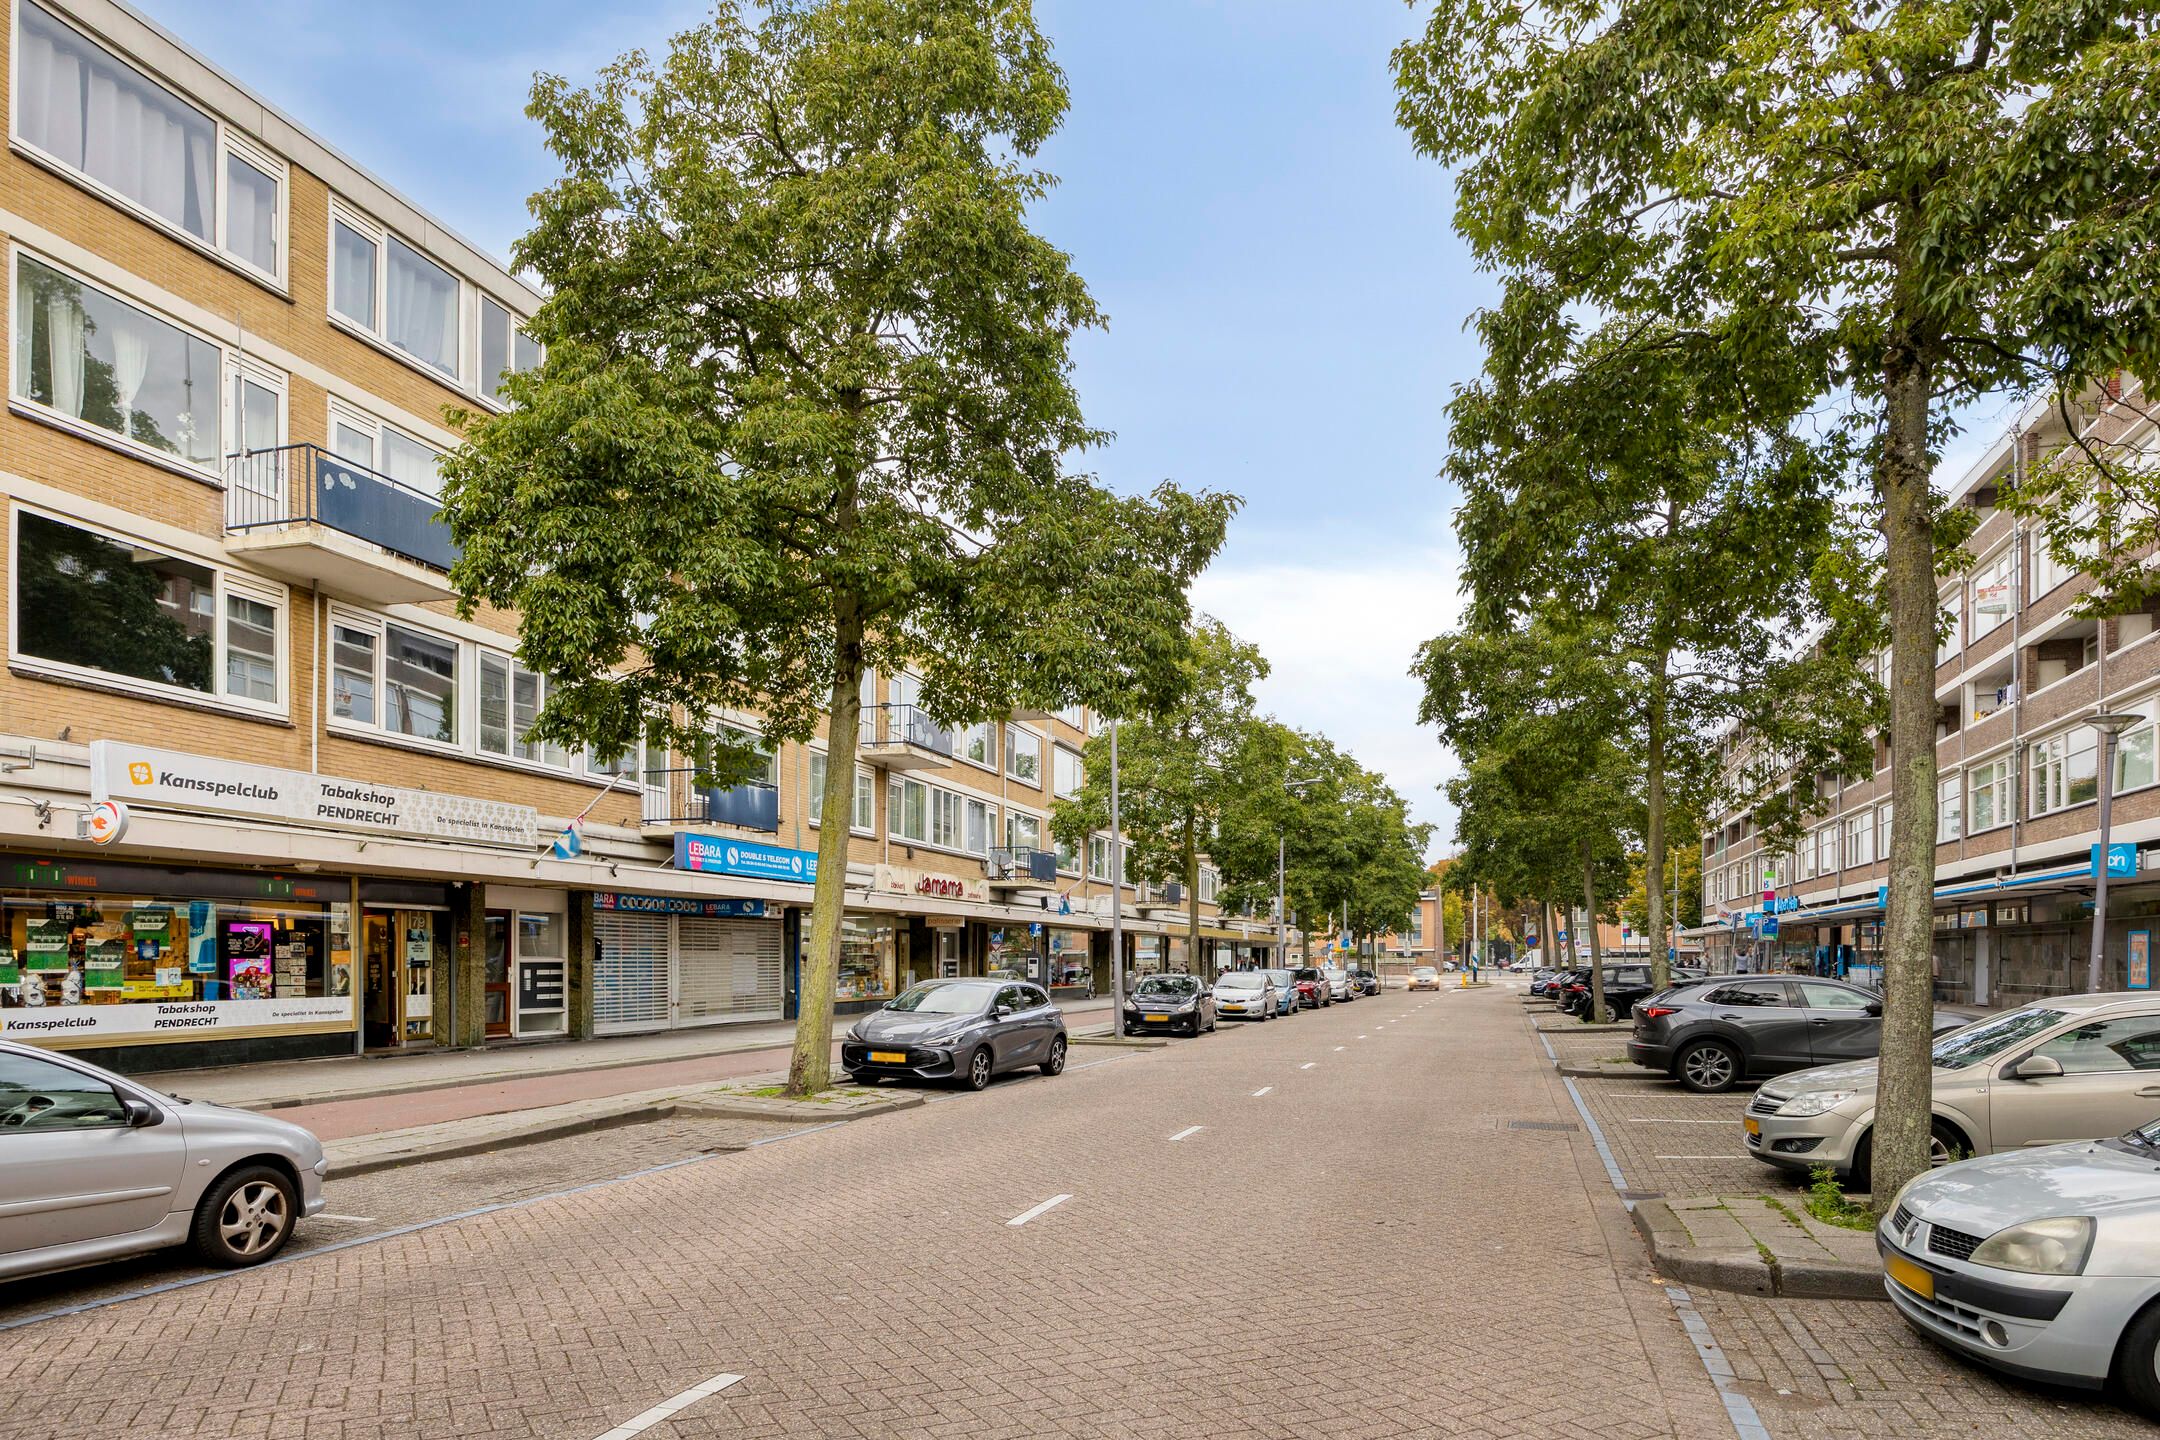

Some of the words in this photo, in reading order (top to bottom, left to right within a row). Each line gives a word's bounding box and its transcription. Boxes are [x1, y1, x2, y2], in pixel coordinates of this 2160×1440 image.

[159, 771, 279, 801] Kansspelclub
[320, 783, 396, 808] Tabakshop
[316, 804, 400, 826] PENDRECHT
[437, 816, 447, 824] De
[448, 817, 480, 829] specialist
[481, 821, 488, 829] in
[489, 822, 525, 833] Kansspelen
[688, 841, 722, 859] LEBARA
[740, 851, 762, 861] DOUBLE
[767, 854, 791, 865] TELECOM
[66, 875, 97, 887] WINKEL
[705, 903, 731, 912] LEBARA
[411, 915, 426, 928] 79
[927, 916, 961, 926] patisserie
[1763, 918, 1769, 927] P
[156, 1003, 216, 1015] Tabakshop
[280, 1010, 307, 1018] specialist
[314, 1008, 344, 1017] Kansspelen
[7, 1017, 97, 1031] Kansspelclub
[154, 1016, 219, 1029] PENDRECHT
